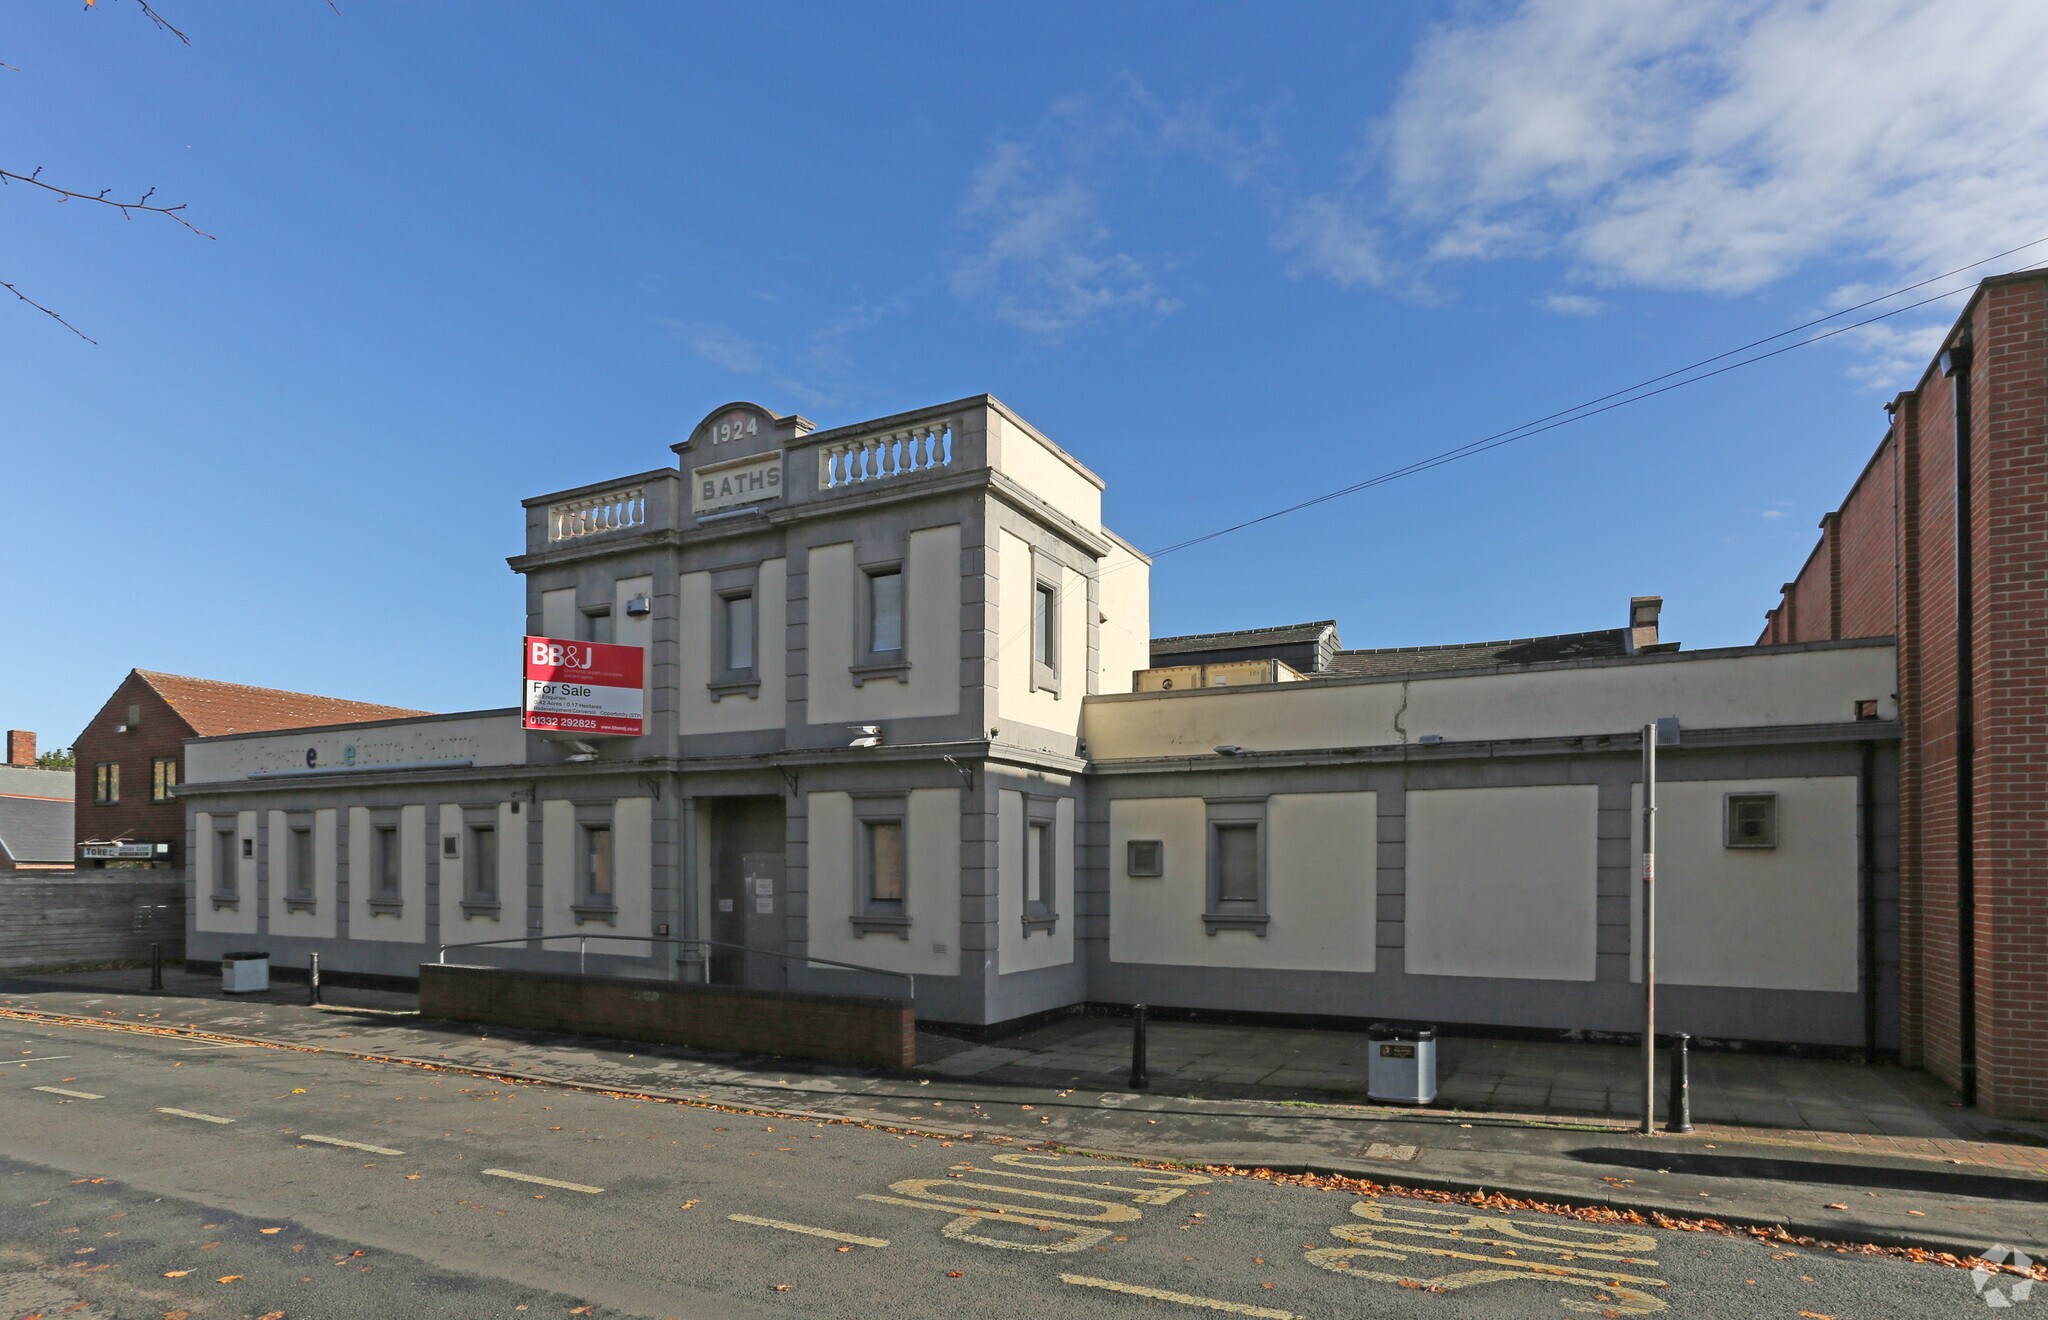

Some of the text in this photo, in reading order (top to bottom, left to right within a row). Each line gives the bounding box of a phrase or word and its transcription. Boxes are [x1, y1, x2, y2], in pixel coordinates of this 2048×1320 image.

[713, 417, 758, 445] 1924
[703, 467, 781, 500] BATHS
[532, 642, 592, 669] BB&J
[534, 682, 591, 697] For Sale
[530, 715, 558, 726] 01332
[561, 718, 597, 728] 292825
[600, 710, 628, 718] Opportunity
[86, 847, 108, 856] Take
[855, 1153, 1214, 1254] STOP
[1304, 1200, 1671, 1315] BUS
